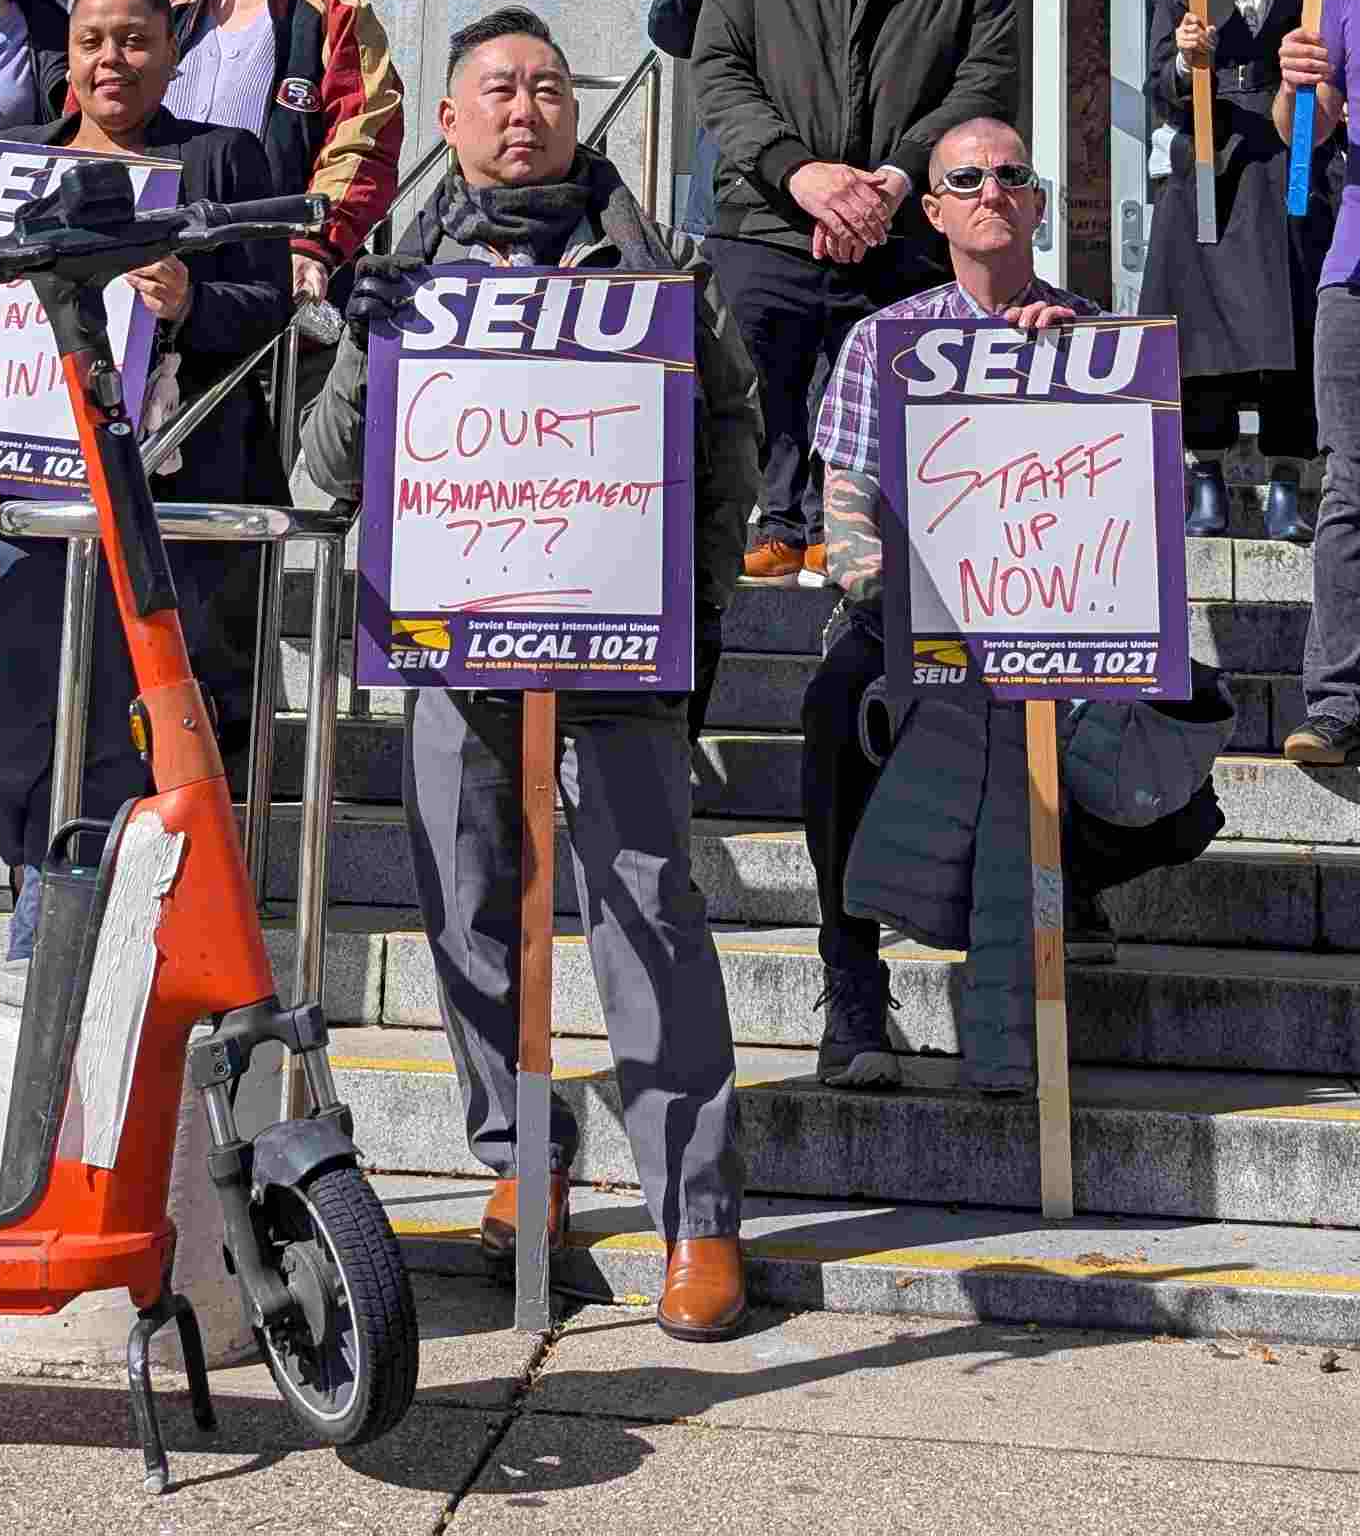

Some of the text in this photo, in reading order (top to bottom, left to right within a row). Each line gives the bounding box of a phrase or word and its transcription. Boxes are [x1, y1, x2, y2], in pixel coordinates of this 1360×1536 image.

[400, 277, 660, 351] SEIU
[908, 326, 1144, 397] SEIU
[403, 371, 641, 463] COURT
[42, 455, 88, 480] 102
[916, 416, 1125, 535] STAFF
[398, 477, 686, 520] MISMANAGEMENT
[1003, 511, 1058, 560] UP
[958, 517, 1132, 625] NOW!!
[468, 619, 660, 633] Service Employees International Union
[388, 649, 449, 671] SEIU
[467, 633, 659, 661] LOCAL 1021
[982, 640, 1160, 652] Service Employees International Union
[982, 651, 1158, 675] LOCAL 1021
[912, 667, 968, 686] SEIU
